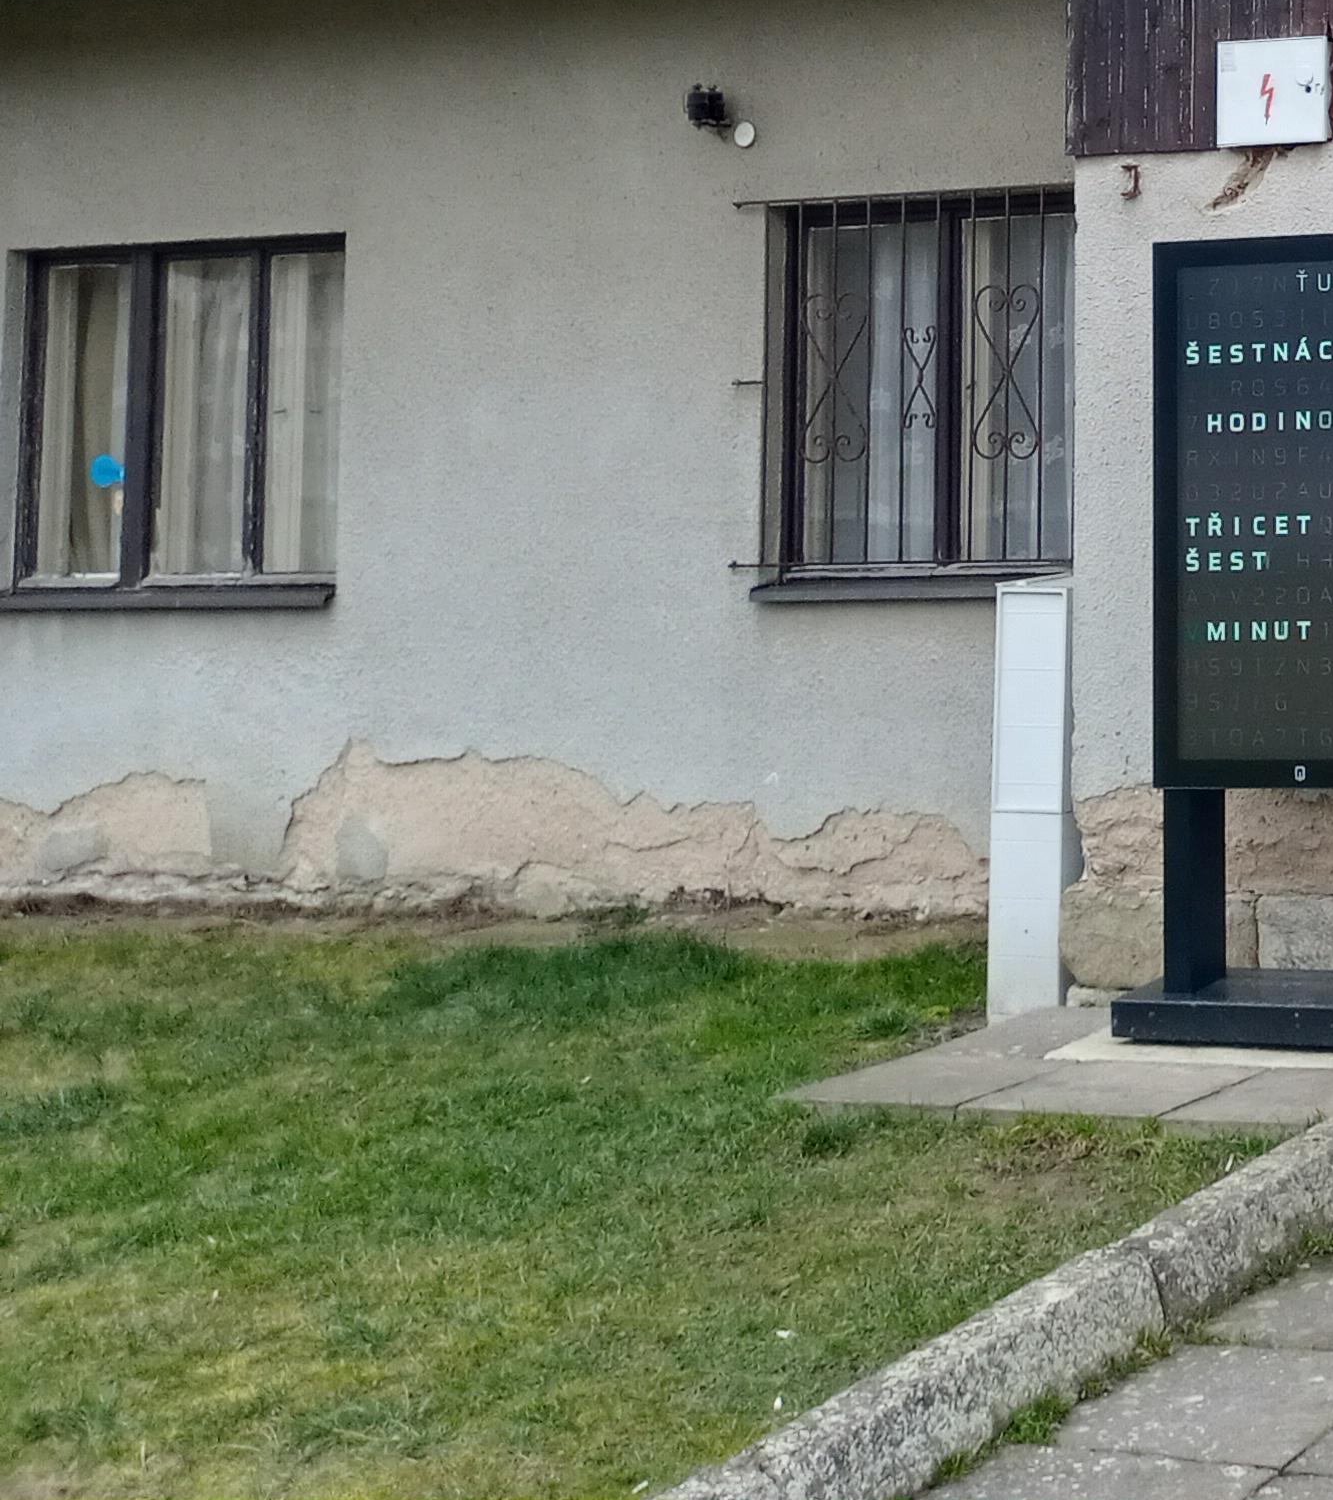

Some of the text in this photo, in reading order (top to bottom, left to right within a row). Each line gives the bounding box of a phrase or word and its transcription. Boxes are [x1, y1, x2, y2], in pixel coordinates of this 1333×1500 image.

[1185, 511, 1312, 537] TŘICET
[1185, 547, 1267, 572] ŠEST
[1206, 620, 1312, 642] MINUT
